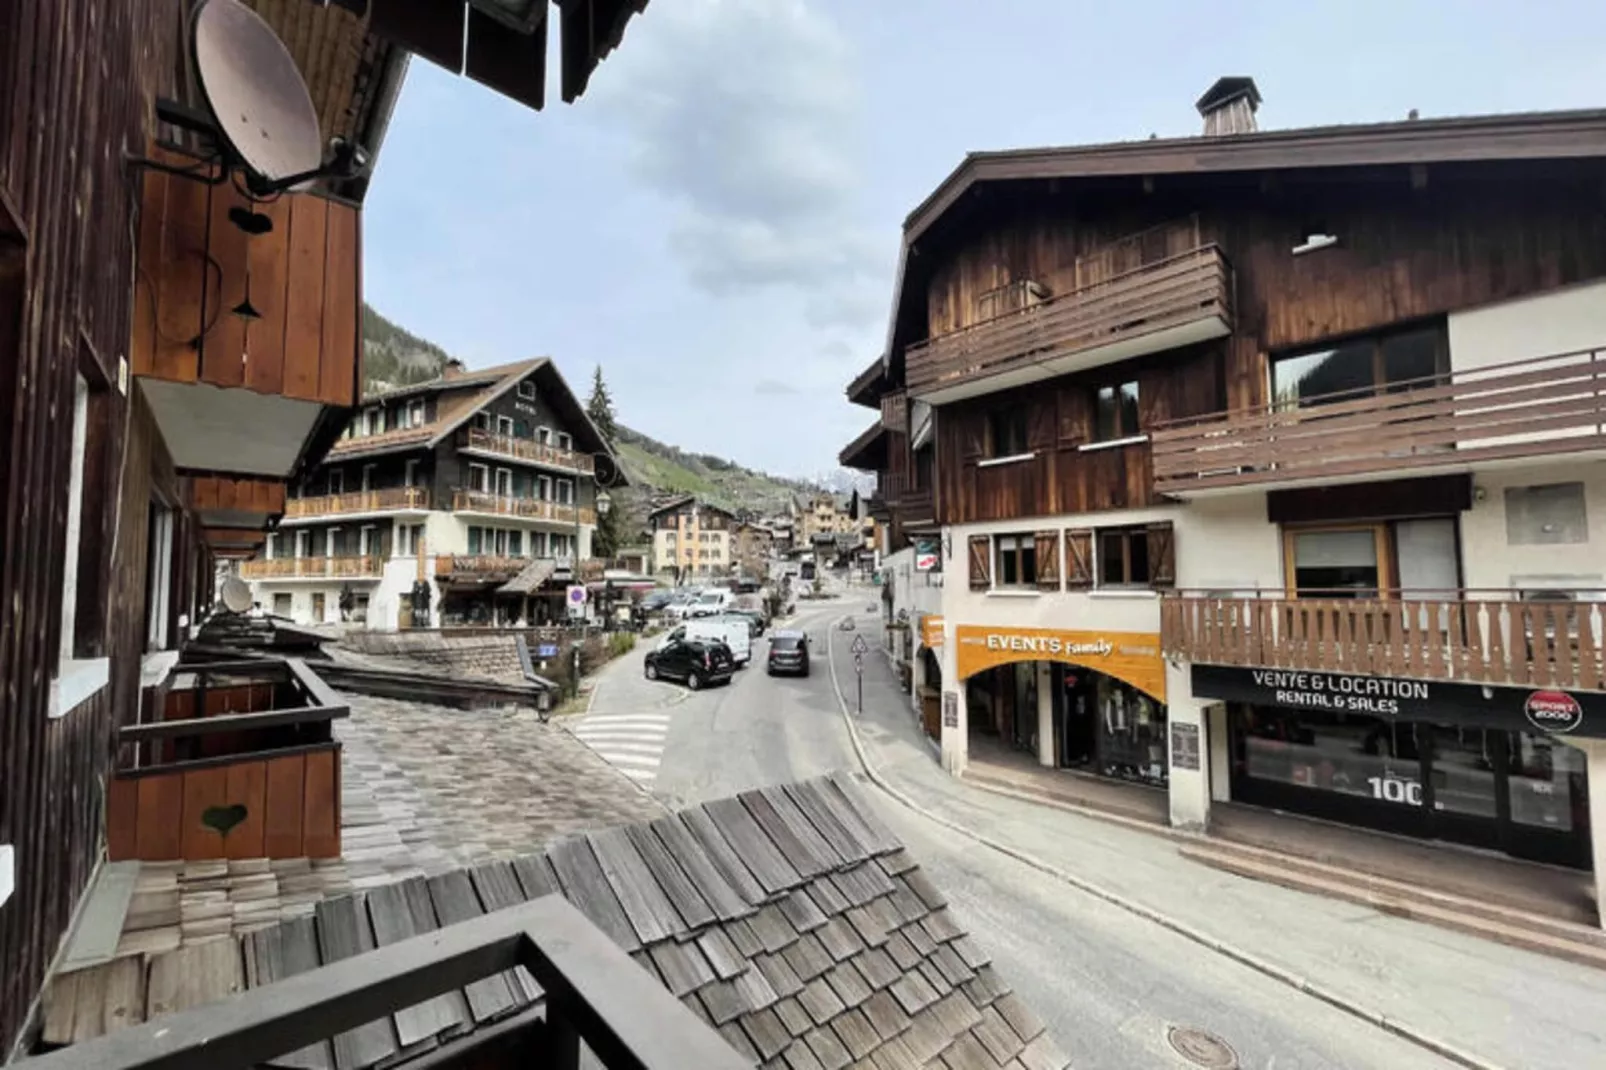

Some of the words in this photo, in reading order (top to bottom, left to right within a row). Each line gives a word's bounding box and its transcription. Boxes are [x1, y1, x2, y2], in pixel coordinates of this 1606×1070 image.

[987, 634, 1062, 653] EVENTS
[1252, 671, 1308, 689] VENTE
[1311, 674, 1324, 690] &
[1328, 676, 1429, 699] LOCATION
[1276, 690, 1332, 708] RENTAL
[1334, 695, 1345, 708] &
[1347, 697, 1398, 714] SALES
